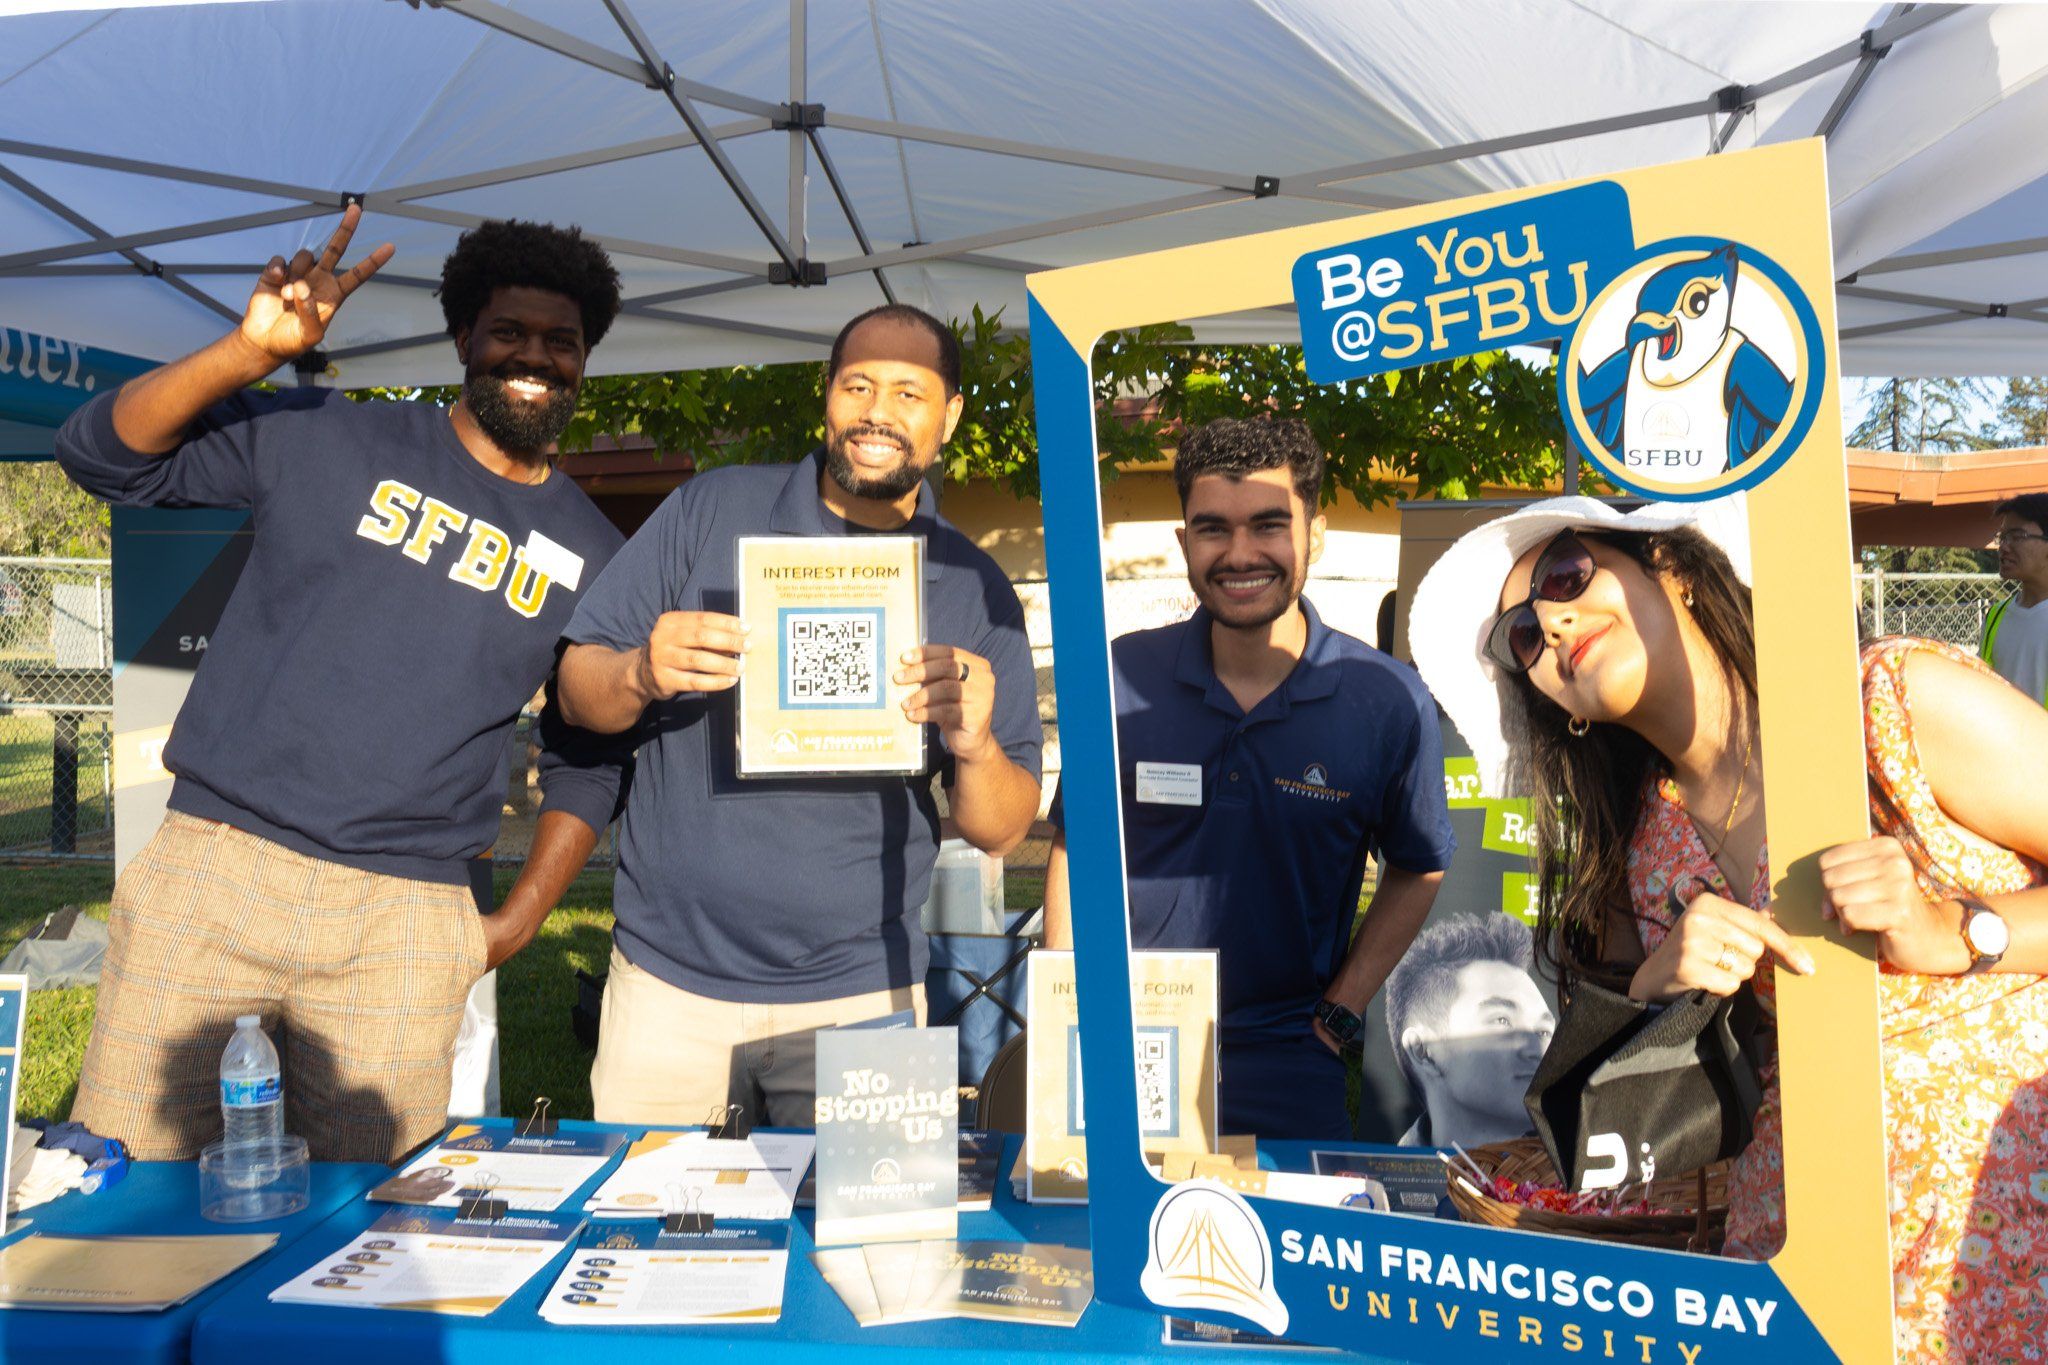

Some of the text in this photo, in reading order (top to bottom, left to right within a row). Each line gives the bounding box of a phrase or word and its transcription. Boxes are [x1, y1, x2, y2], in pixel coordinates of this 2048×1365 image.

[1317, 224, 1544, 310] Be You
[1331, 261, 1589, 362] @SFBU
[1628, 449, 1703, 467] SFBU
[356, 479, 556, 618] SFBU
[763, 566, 900, 579] INTEREST FORM
[1143, 982, 1194, 996] FORM
[842, 1068, 890, 1098] No
[814, 1085, 959, 1124] Stopping
[900, 1116, 943, 1144] Us
[837, 1185, 858, 1196] SAN
[1281, 1229, 1777, 1336] SAN FRANCISCO BAY
[1327, 1284, 1704, 1365] UNIVERSITY
